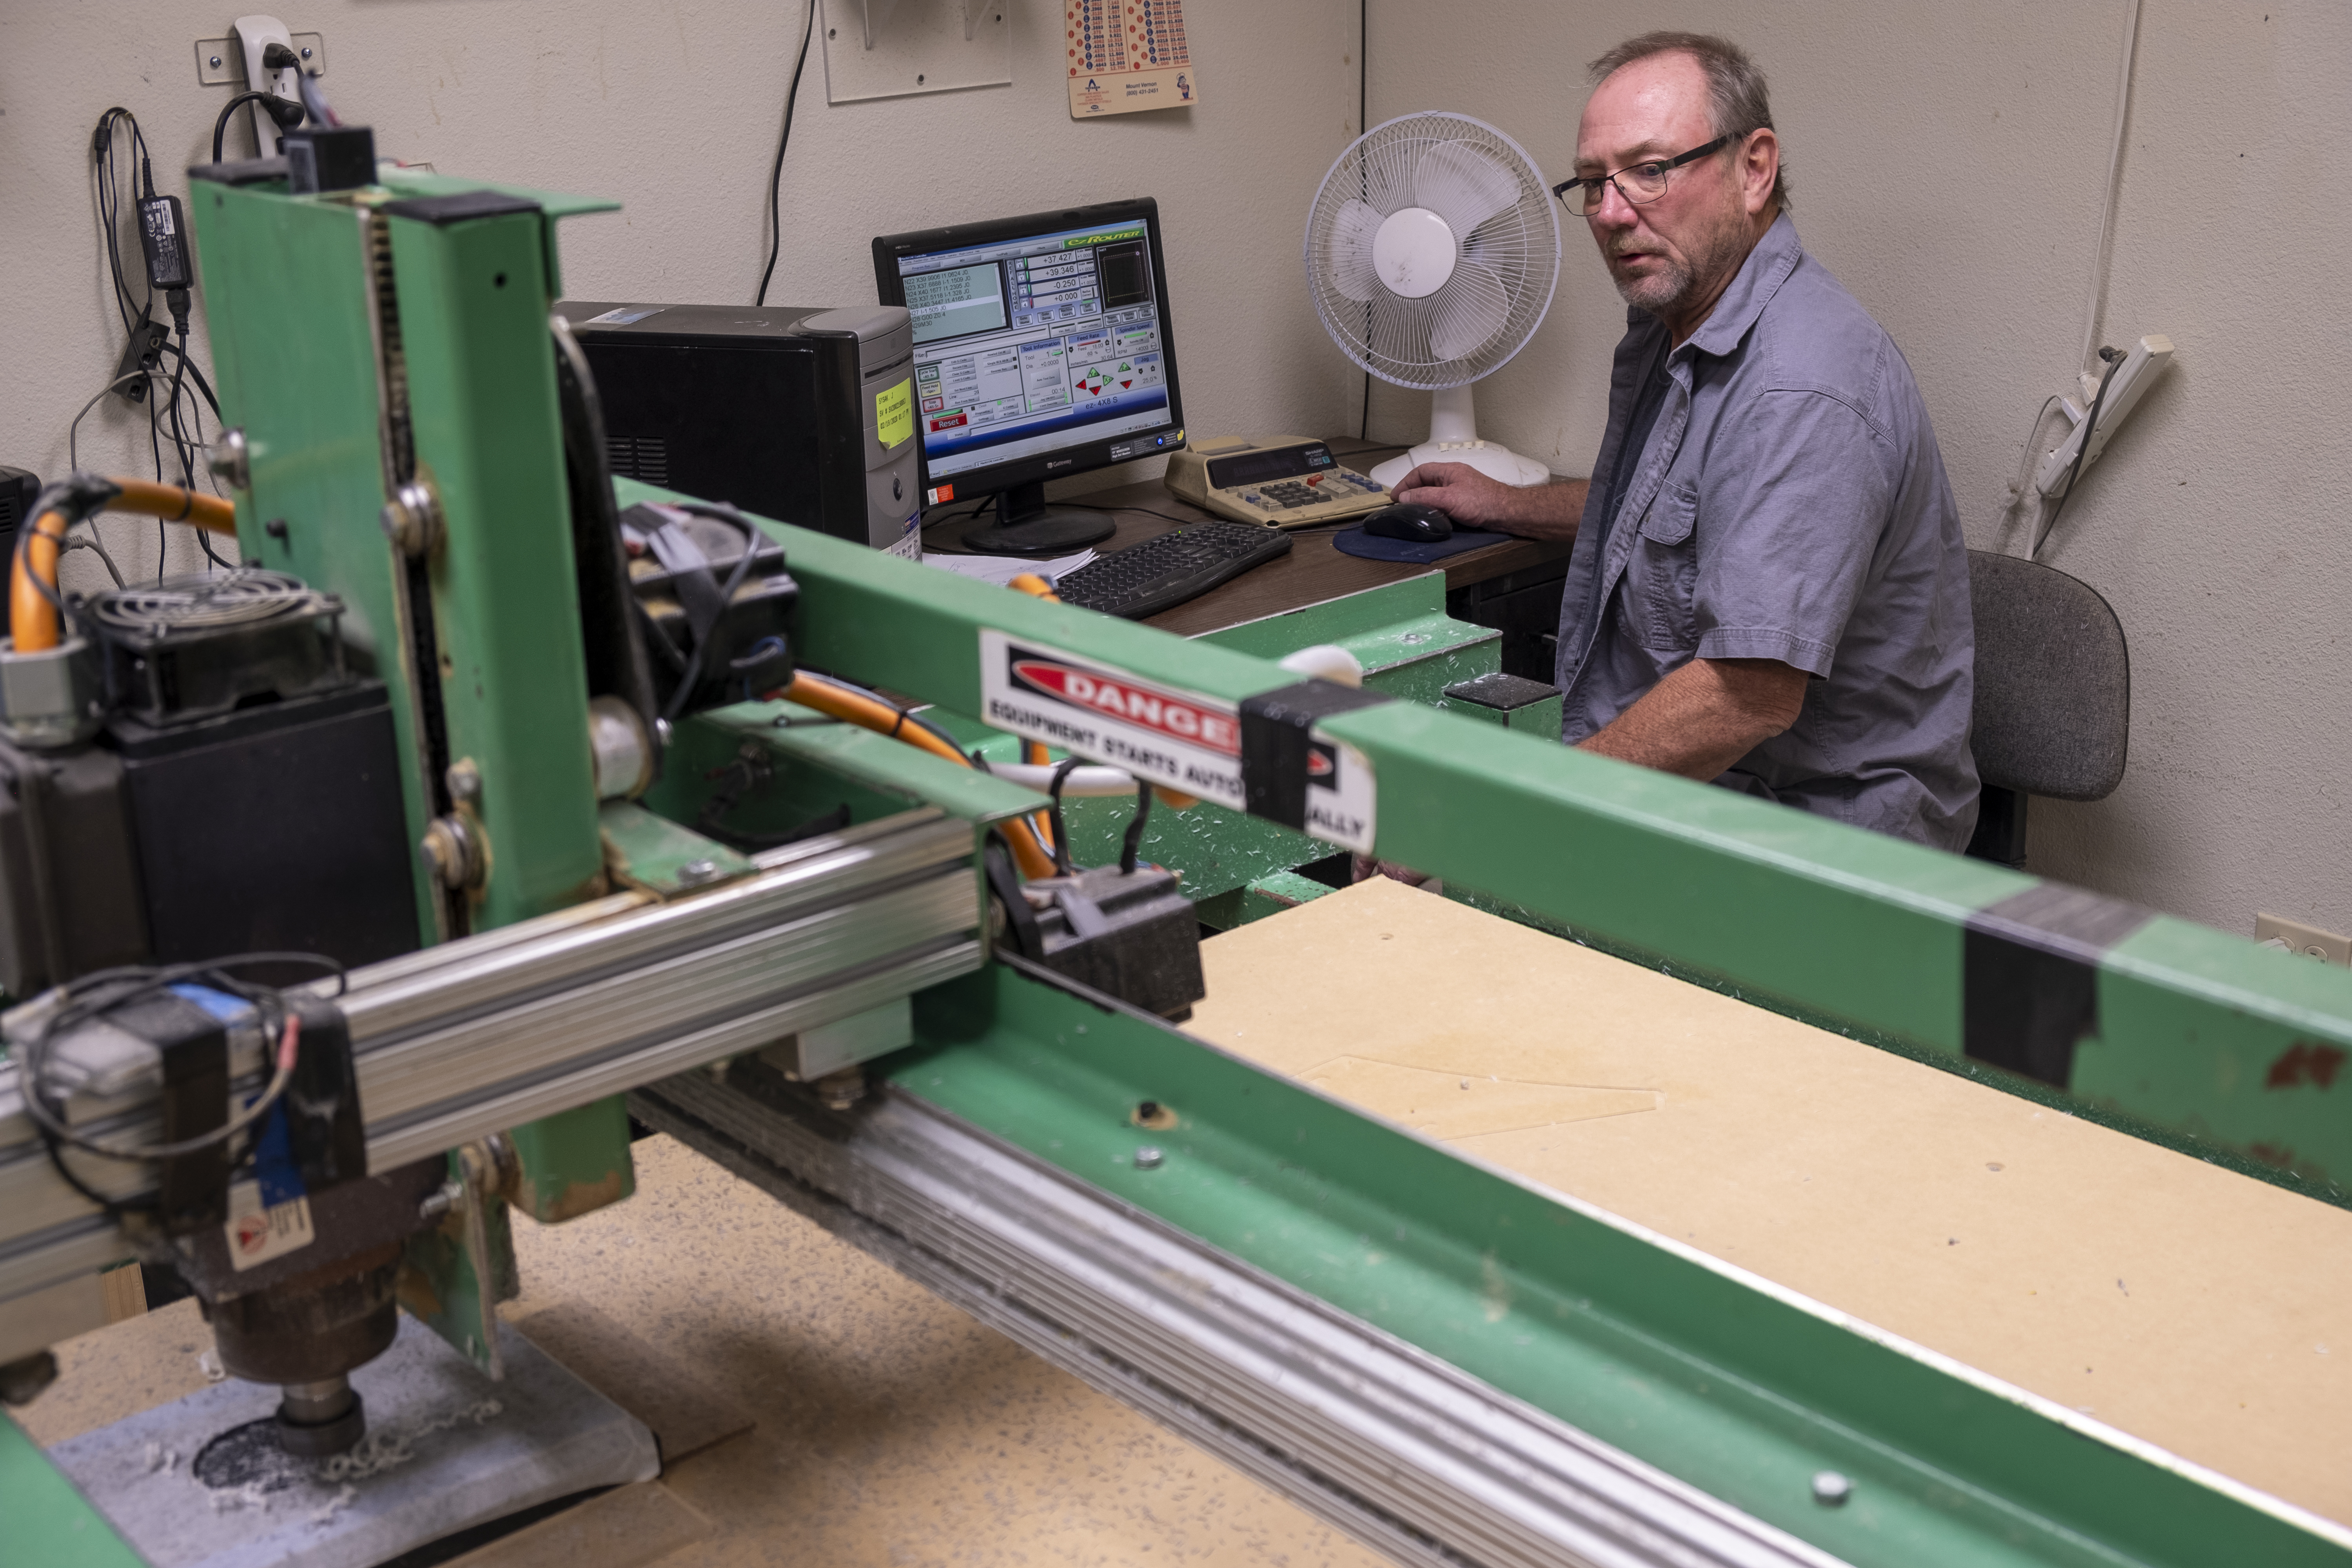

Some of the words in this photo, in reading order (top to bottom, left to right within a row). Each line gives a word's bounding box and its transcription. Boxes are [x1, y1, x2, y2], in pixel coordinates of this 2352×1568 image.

[1044, 253, 1071, 263] +37.427
[1046, 266, 1074, 276] +39.346
[1053, 279, 1076, 289] -0.250
[1054, 292, 1078, 301] +0.000
[1034, 341, 1060, 350] Information
[1098, 398, 1111, 406] 4X8
[880, 416, 898, 429] 02/19/2020
[939, 419, 960, 428] Reset
[1053, 459, 1072, 468] Gateway
[1064, 673, 1234, 751] DANGE
[989, 698, 1097, 755] EQUIPMENT
[1101, 737, 1179, 778] STARTS
